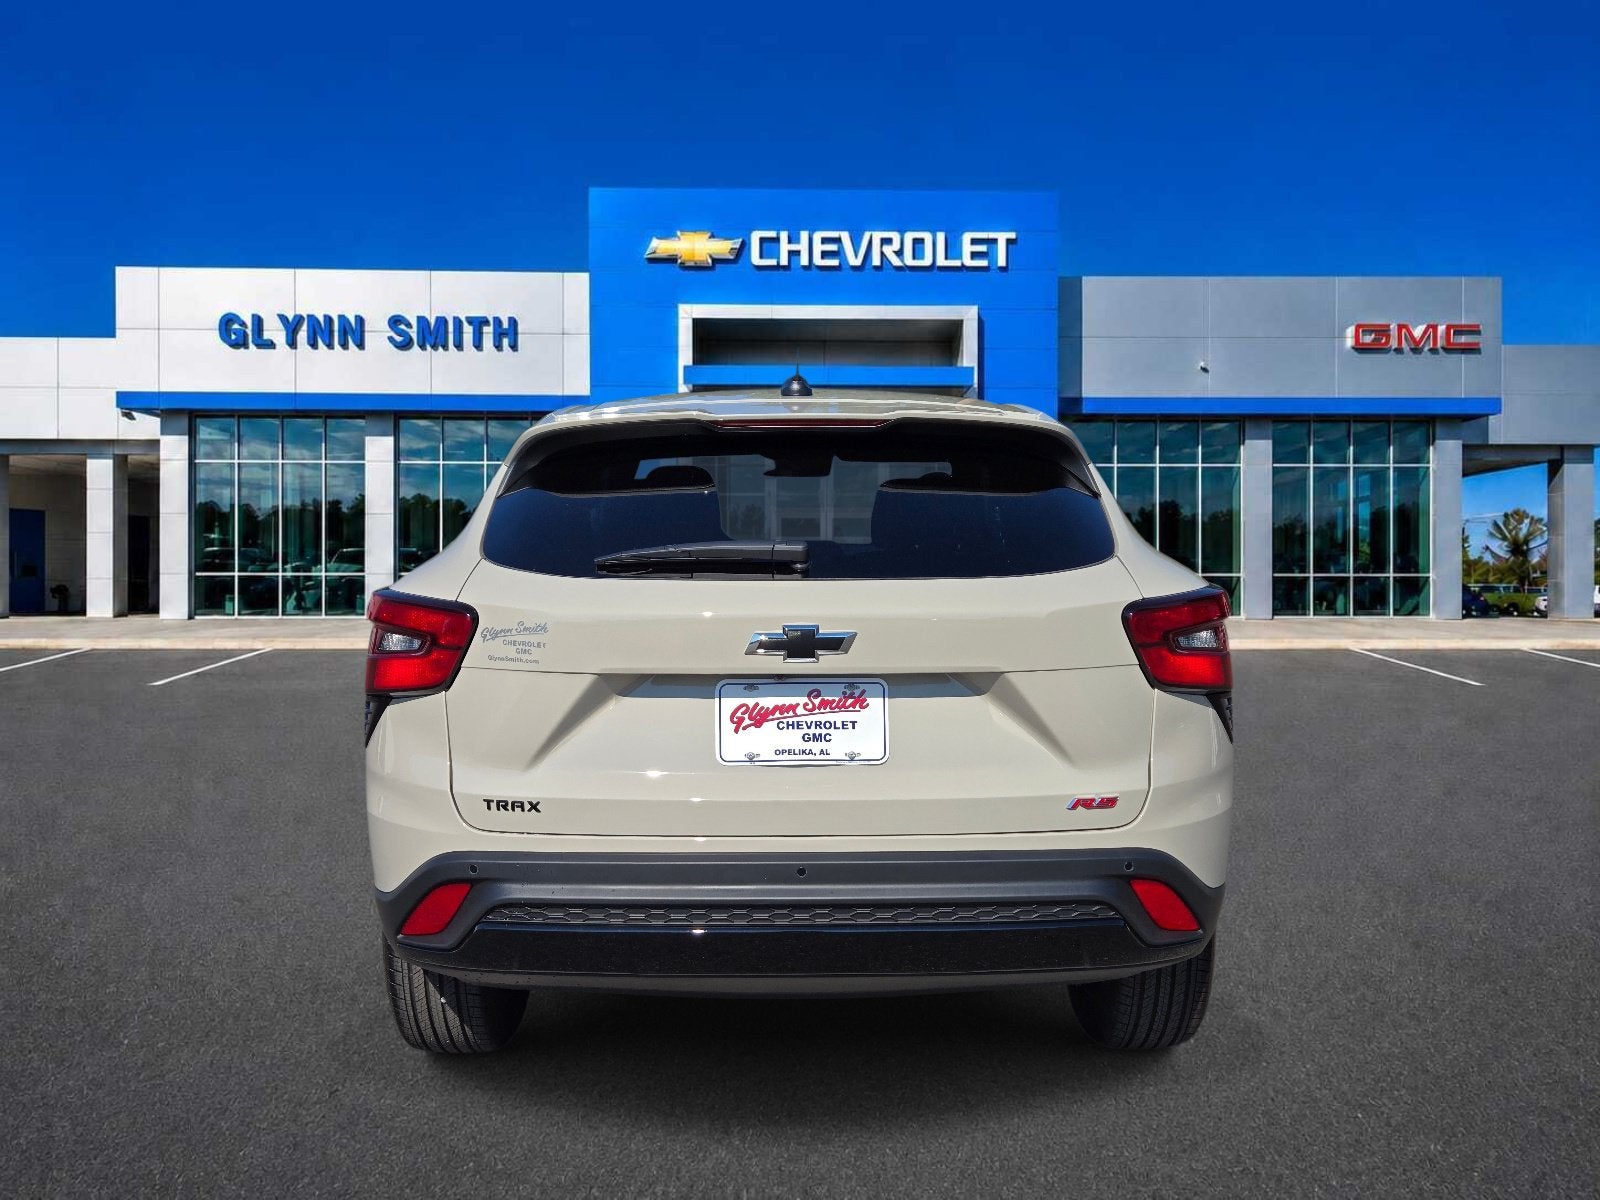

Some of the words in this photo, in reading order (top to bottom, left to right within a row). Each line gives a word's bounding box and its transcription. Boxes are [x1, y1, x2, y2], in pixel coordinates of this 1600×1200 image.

[749, 230, 1017, 268] CHEVROLET
[218, 311, 366, 350] GLYNN
[386, 314, 519, 352] SMITH
[1347, 322, 1482, 354] GMC
[480, 626, 514, 643] Glynn
[515, 620, 549, 635] Smith
[515, 648, 533, 656] GMC
[729, 701, 801, 735] Glynn
[802, 688, 870, 713] Smith
[776, 720, 858, 731] CHEVROLET
[801, 732, 833, 743] GMC
[774, 748, 817, 757] OPELIKA,
[818, 748, 831, 756] AL
[482, 798, 542, 813] TRAX
[1066, 796, 1119, 810] RS
